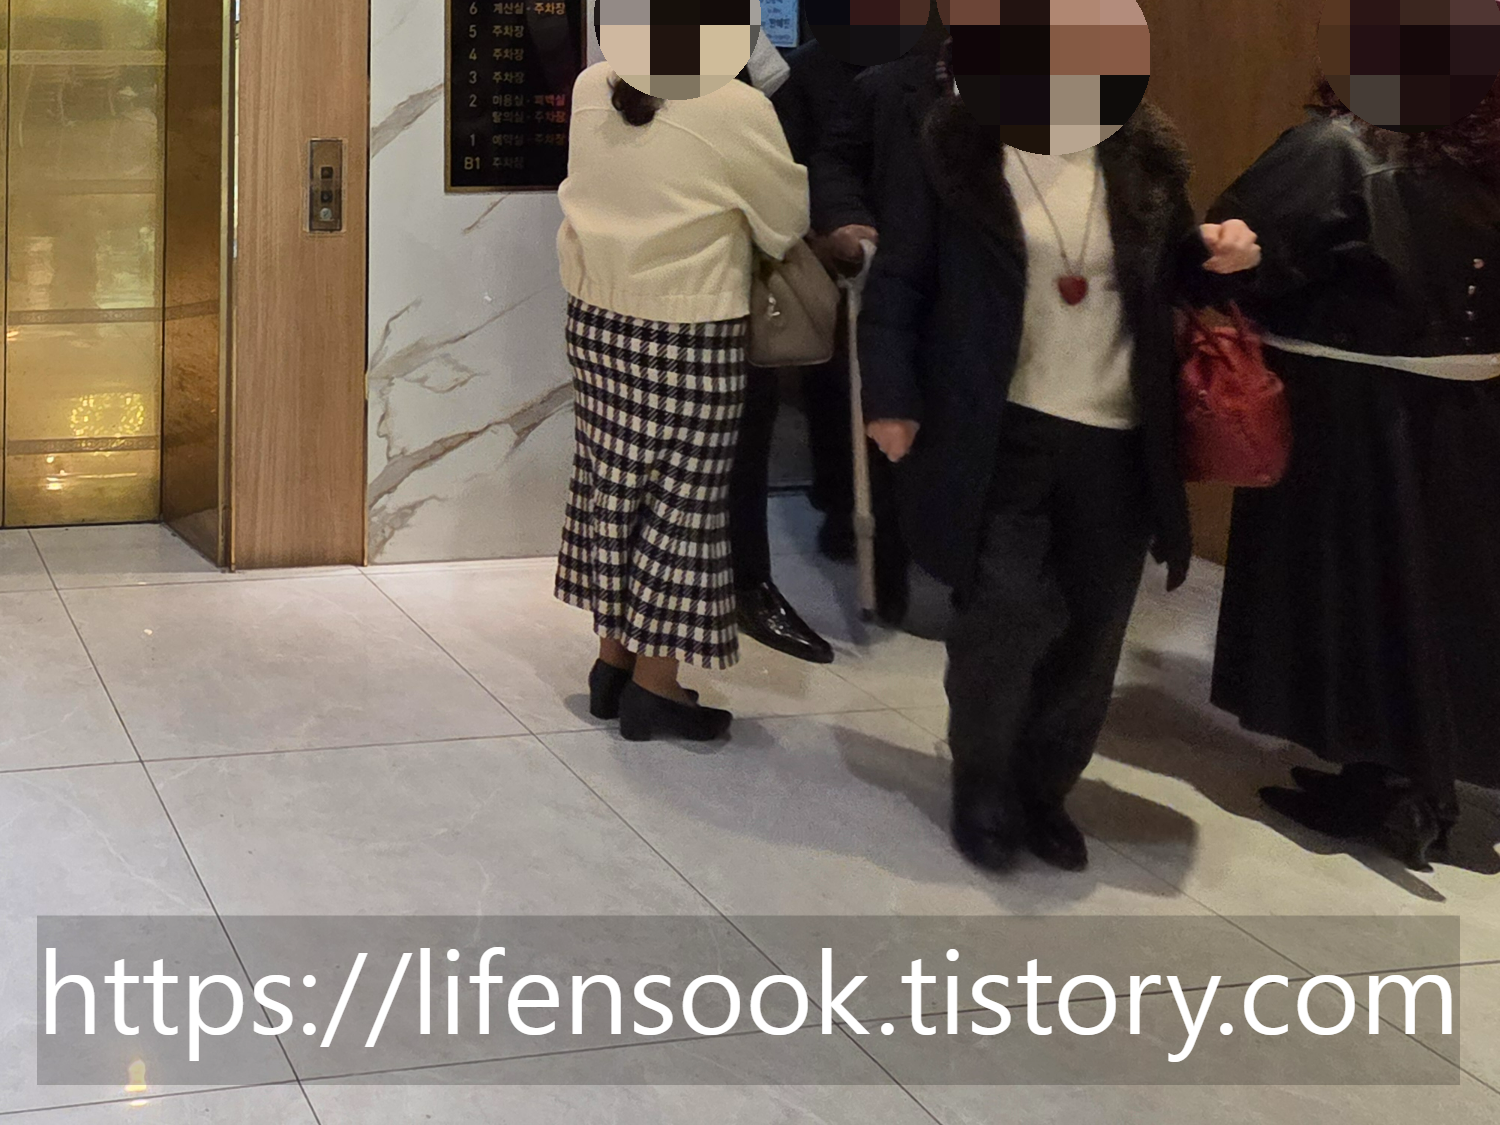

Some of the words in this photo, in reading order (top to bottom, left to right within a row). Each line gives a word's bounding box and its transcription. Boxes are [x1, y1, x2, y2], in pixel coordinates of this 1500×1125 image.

[469, 2, 477, 15] 6
[534, 2, 566, 15] 주차장
[469, 25, 477, 38] 5
[492, 26, 524, 38] 주차장
[469, 48, 477, 61] 4
[493, 48, 524, 61] 주차장
[469, 72, 477, 84] 3
[493, 72, 524, 84] 주차장
[469, 95, 477, 108] 2
[470, 134, 475, 147] 1
[464, 157, 480, 170] B1
